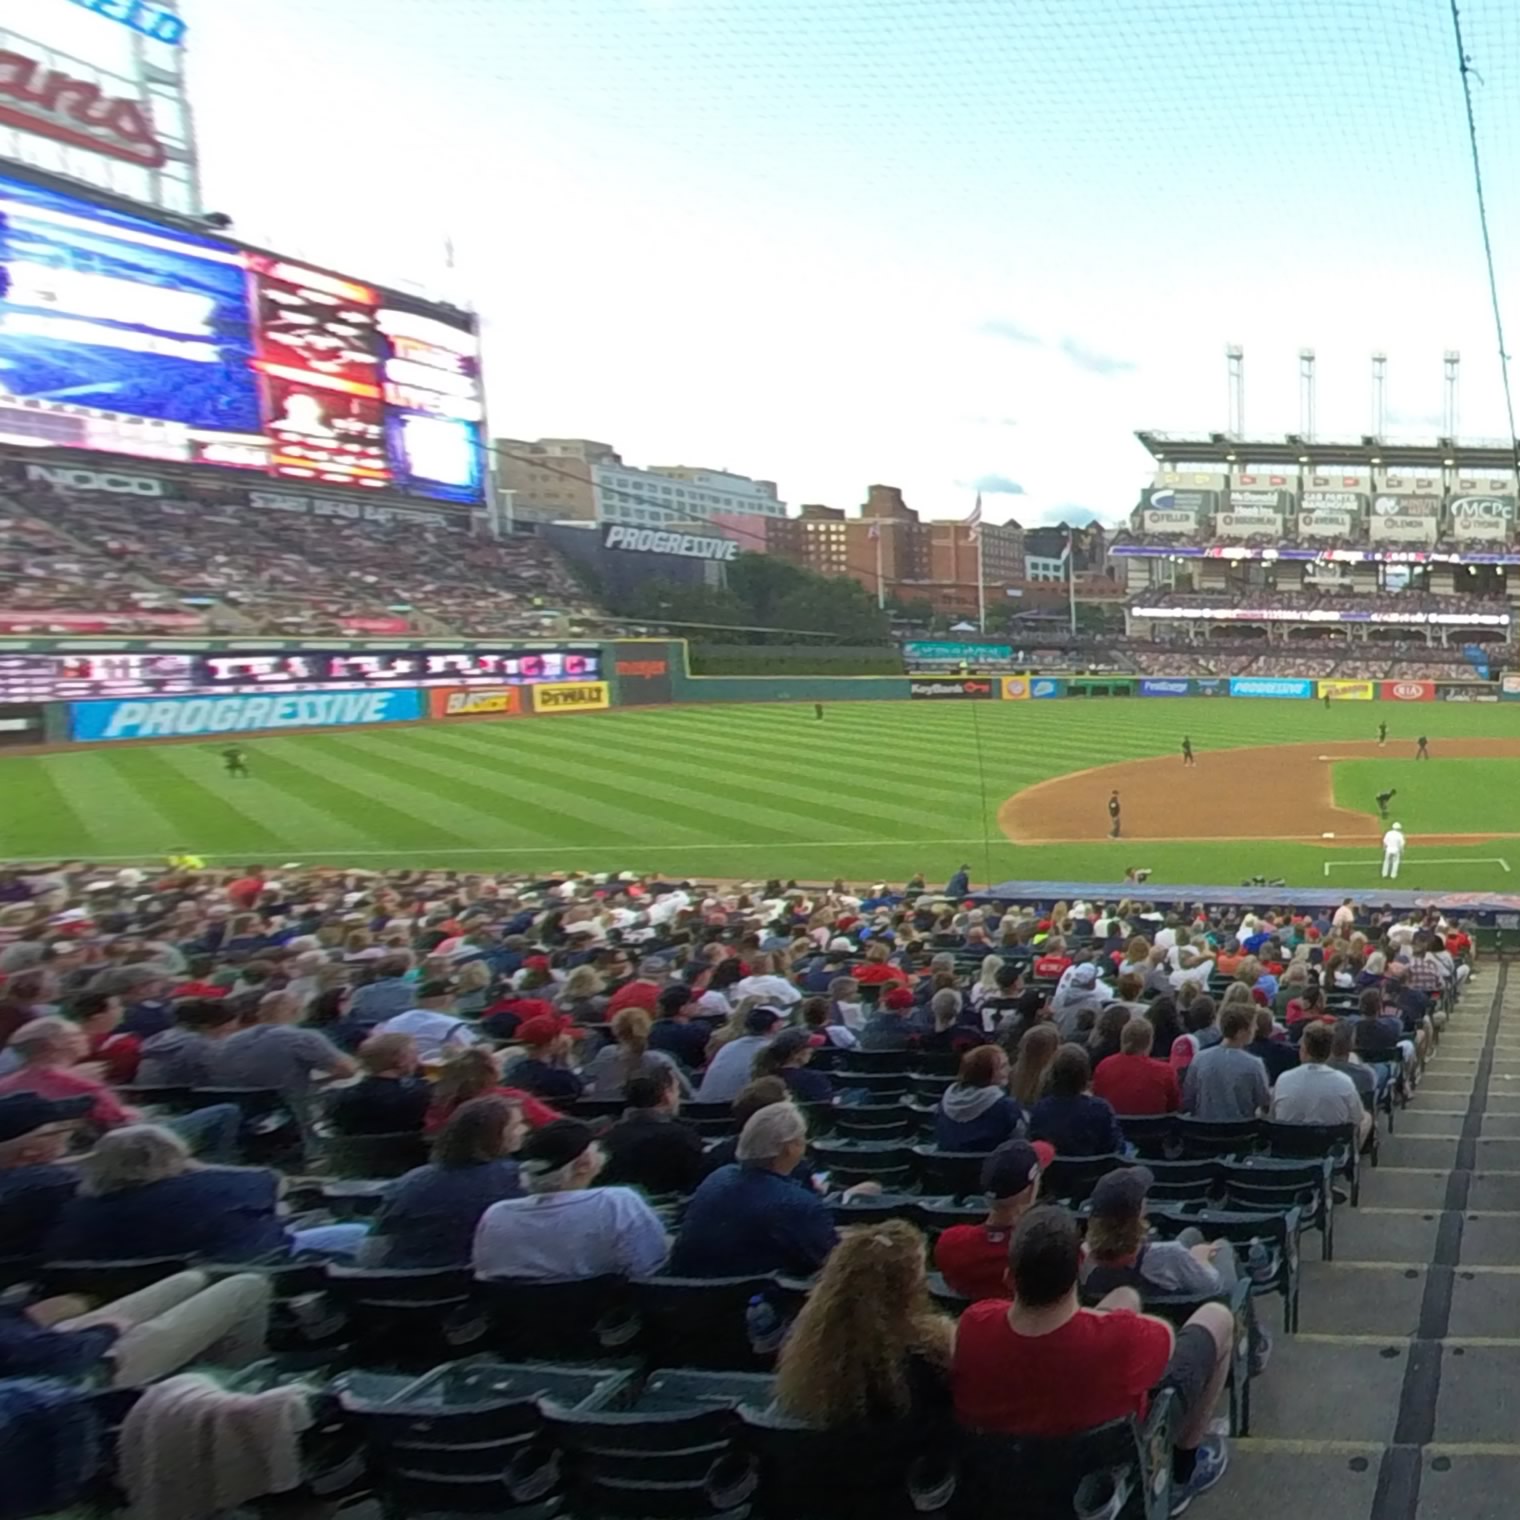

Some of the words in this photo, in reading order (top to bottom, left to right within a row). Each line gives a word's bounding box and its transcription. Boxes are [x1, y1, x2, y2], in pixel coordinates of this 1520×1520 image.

[25, 465, 163, 495] NOCO
[1160, 514, 1190, 523] FELLER
[605, 525, 740, 561] PROGRESSIVE
[911, 683, 964, 696] KeyBank
[101, 692, 396, 738] PROGRESSIVE
